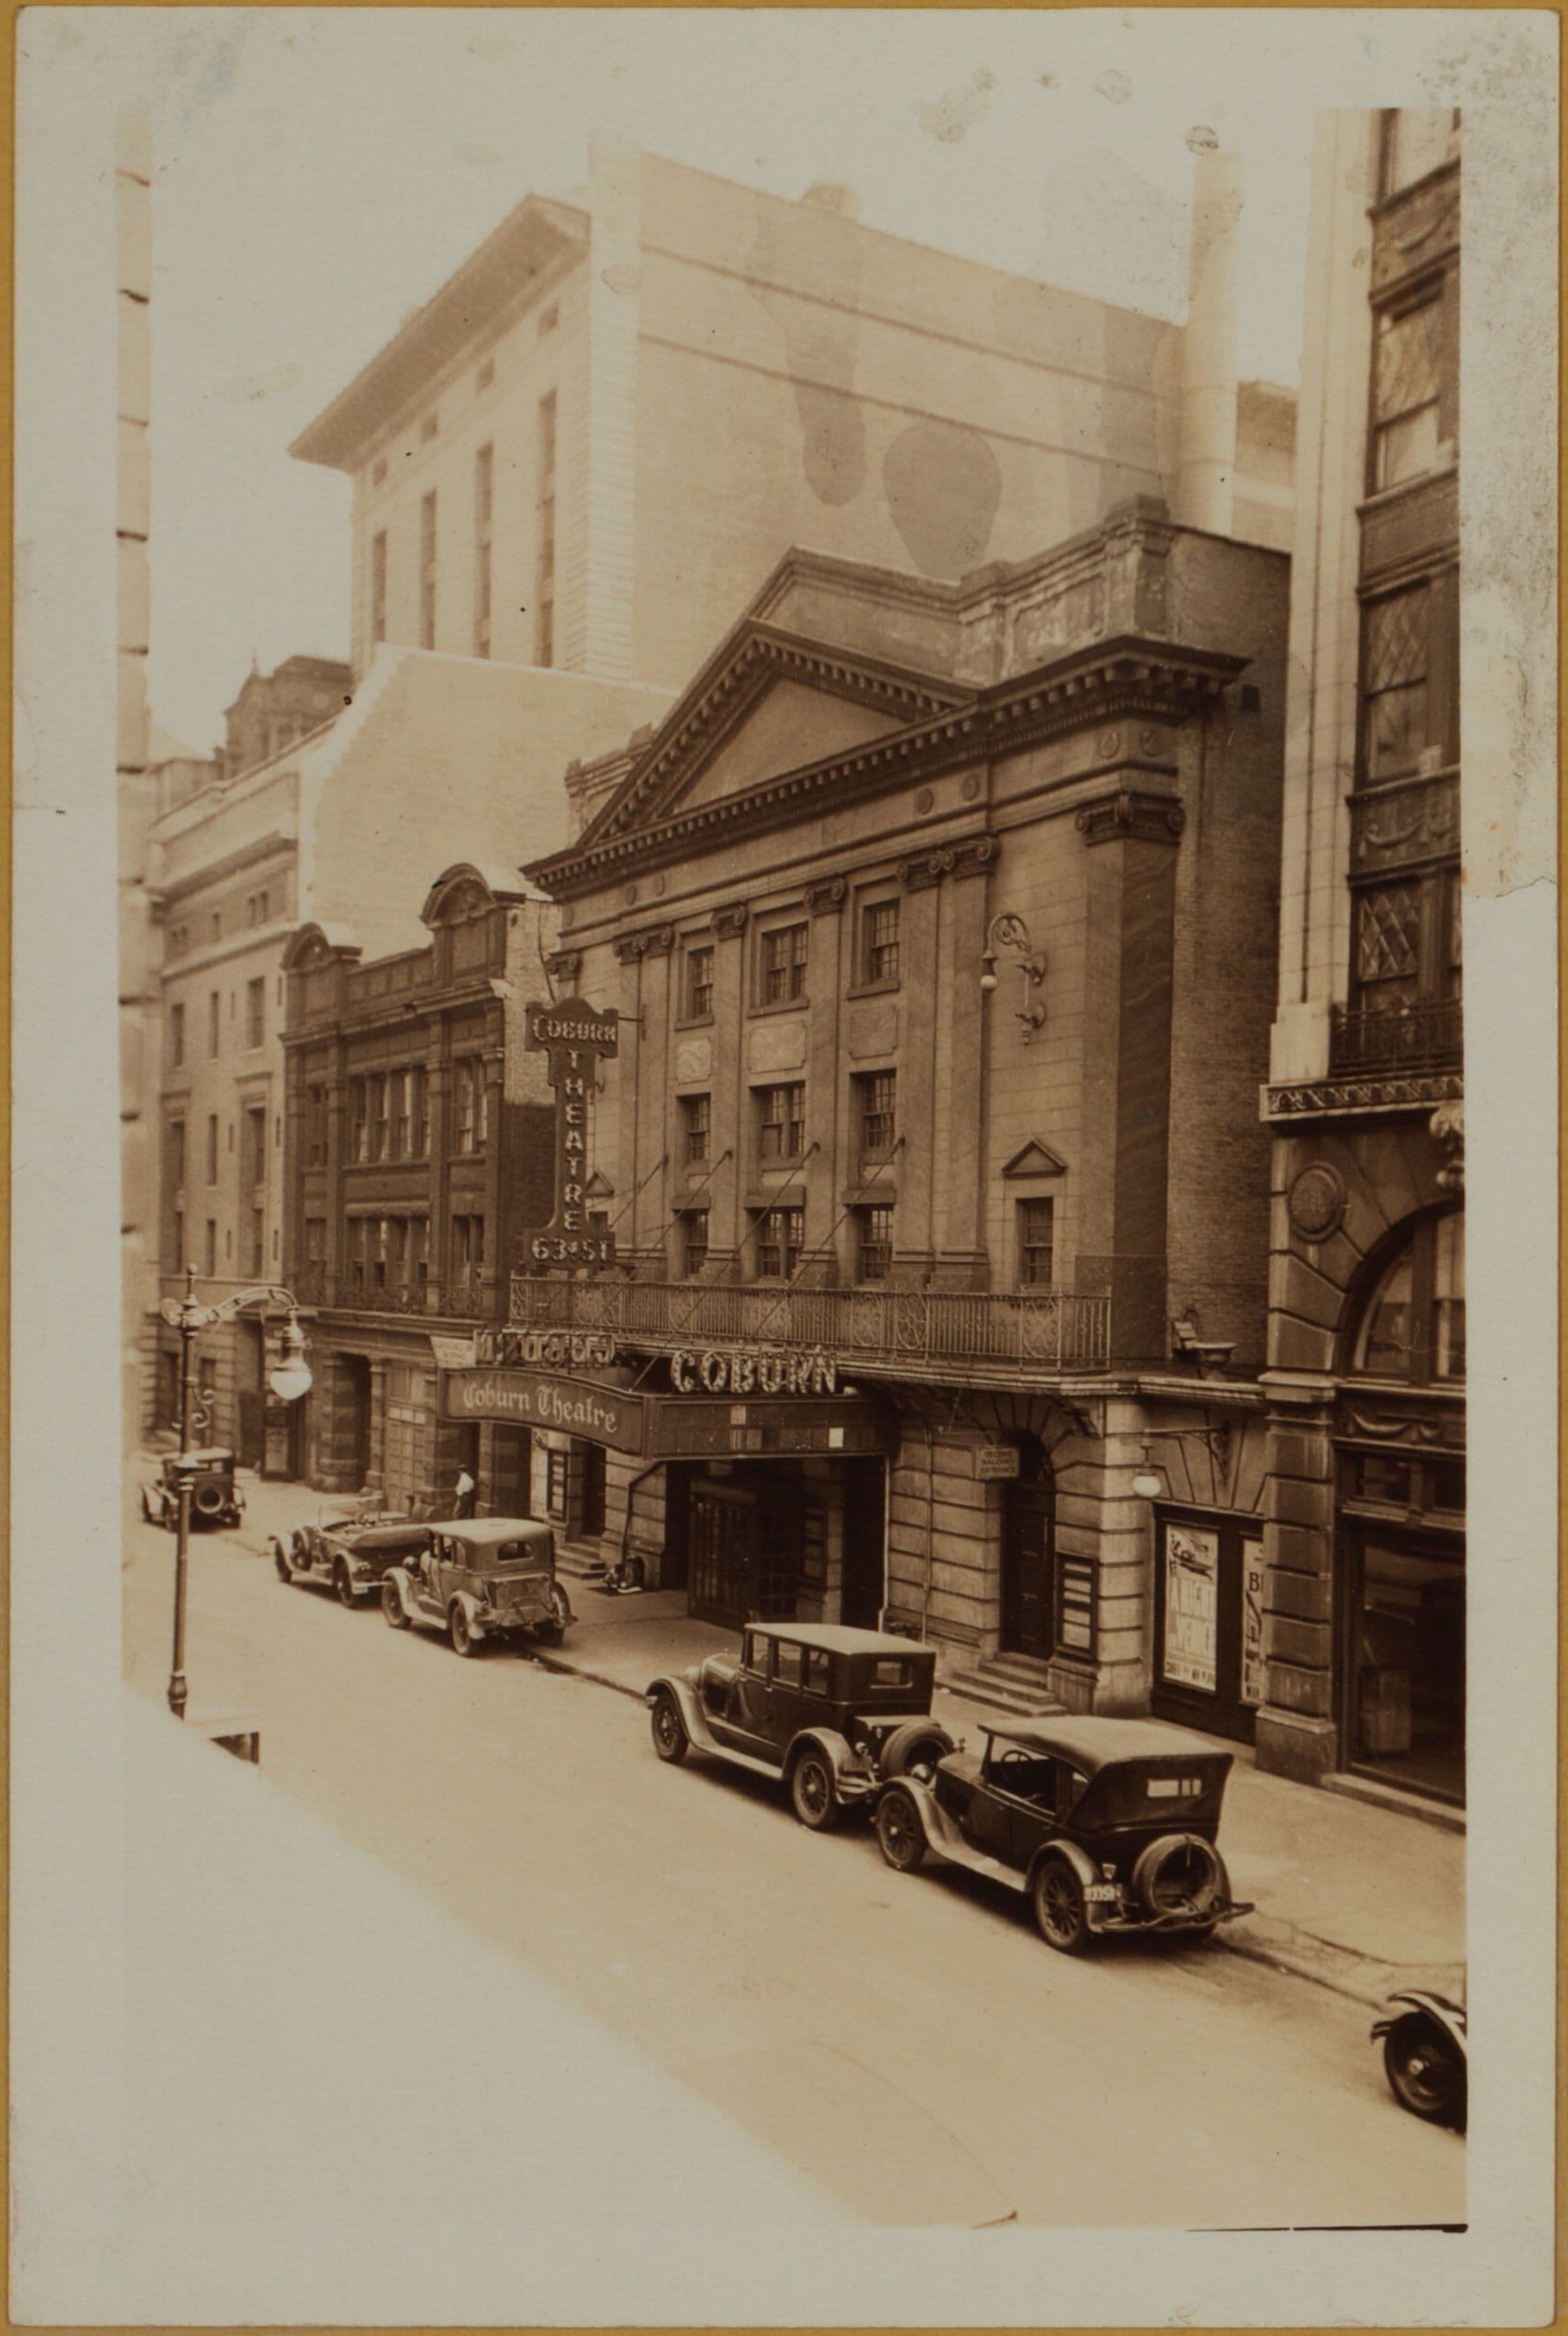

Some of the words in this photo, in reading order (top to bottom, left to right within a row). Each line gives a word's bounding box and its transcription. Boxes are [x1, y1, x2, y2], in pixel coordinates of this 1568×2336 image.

[532, 1015, 617, 1041] COBURN
[564, 1049, 583, 1230] THEATRE
[671, 1349, 837, 1394] COBURN
[463, 1380, 530, 1411] Coburn
[537, 1384, 617, 1433] Theatre
